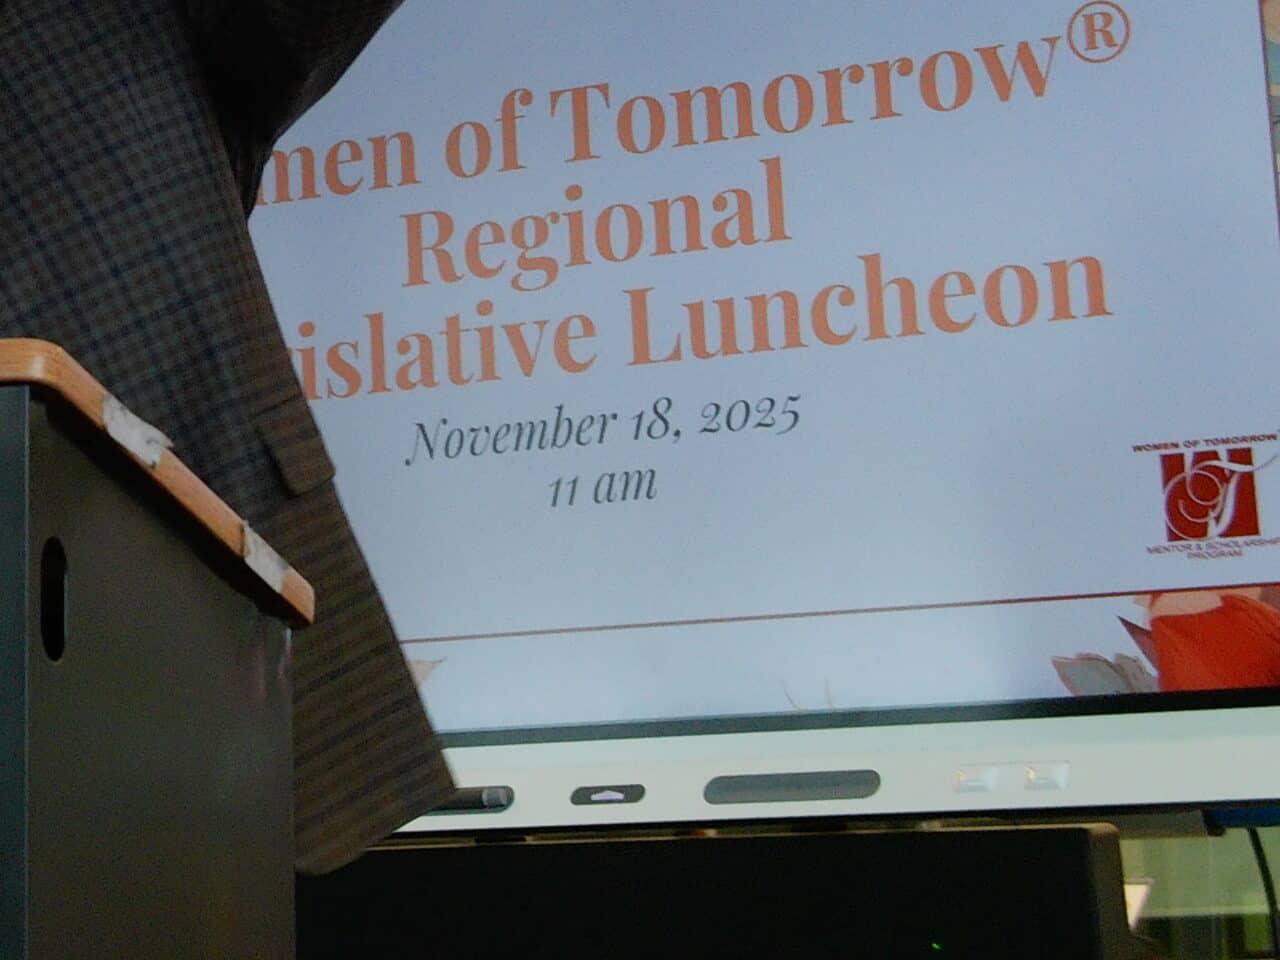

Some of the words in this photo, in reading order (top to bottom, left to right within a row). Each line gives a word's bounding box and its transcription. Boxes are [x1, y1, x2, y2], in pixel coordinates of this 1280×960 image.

[255, 130, 421, 206] men
[445, 88, 533, 178] of
[400, 156, 792, 291] Regional
[288, 299, 597, 401] islative
[623, 253, 1113, 366] Luncheon
[405, 404, 618, 466] November
[630, 396, 682, 444] 18,
[699, 394, 801, 436] 2025
[1132, 442, 1179, 452] WOMEN
[1183, 440, 1199, 448] OF
[548, 476, 579, 508] 11
[593, 468, 657, 505] am
